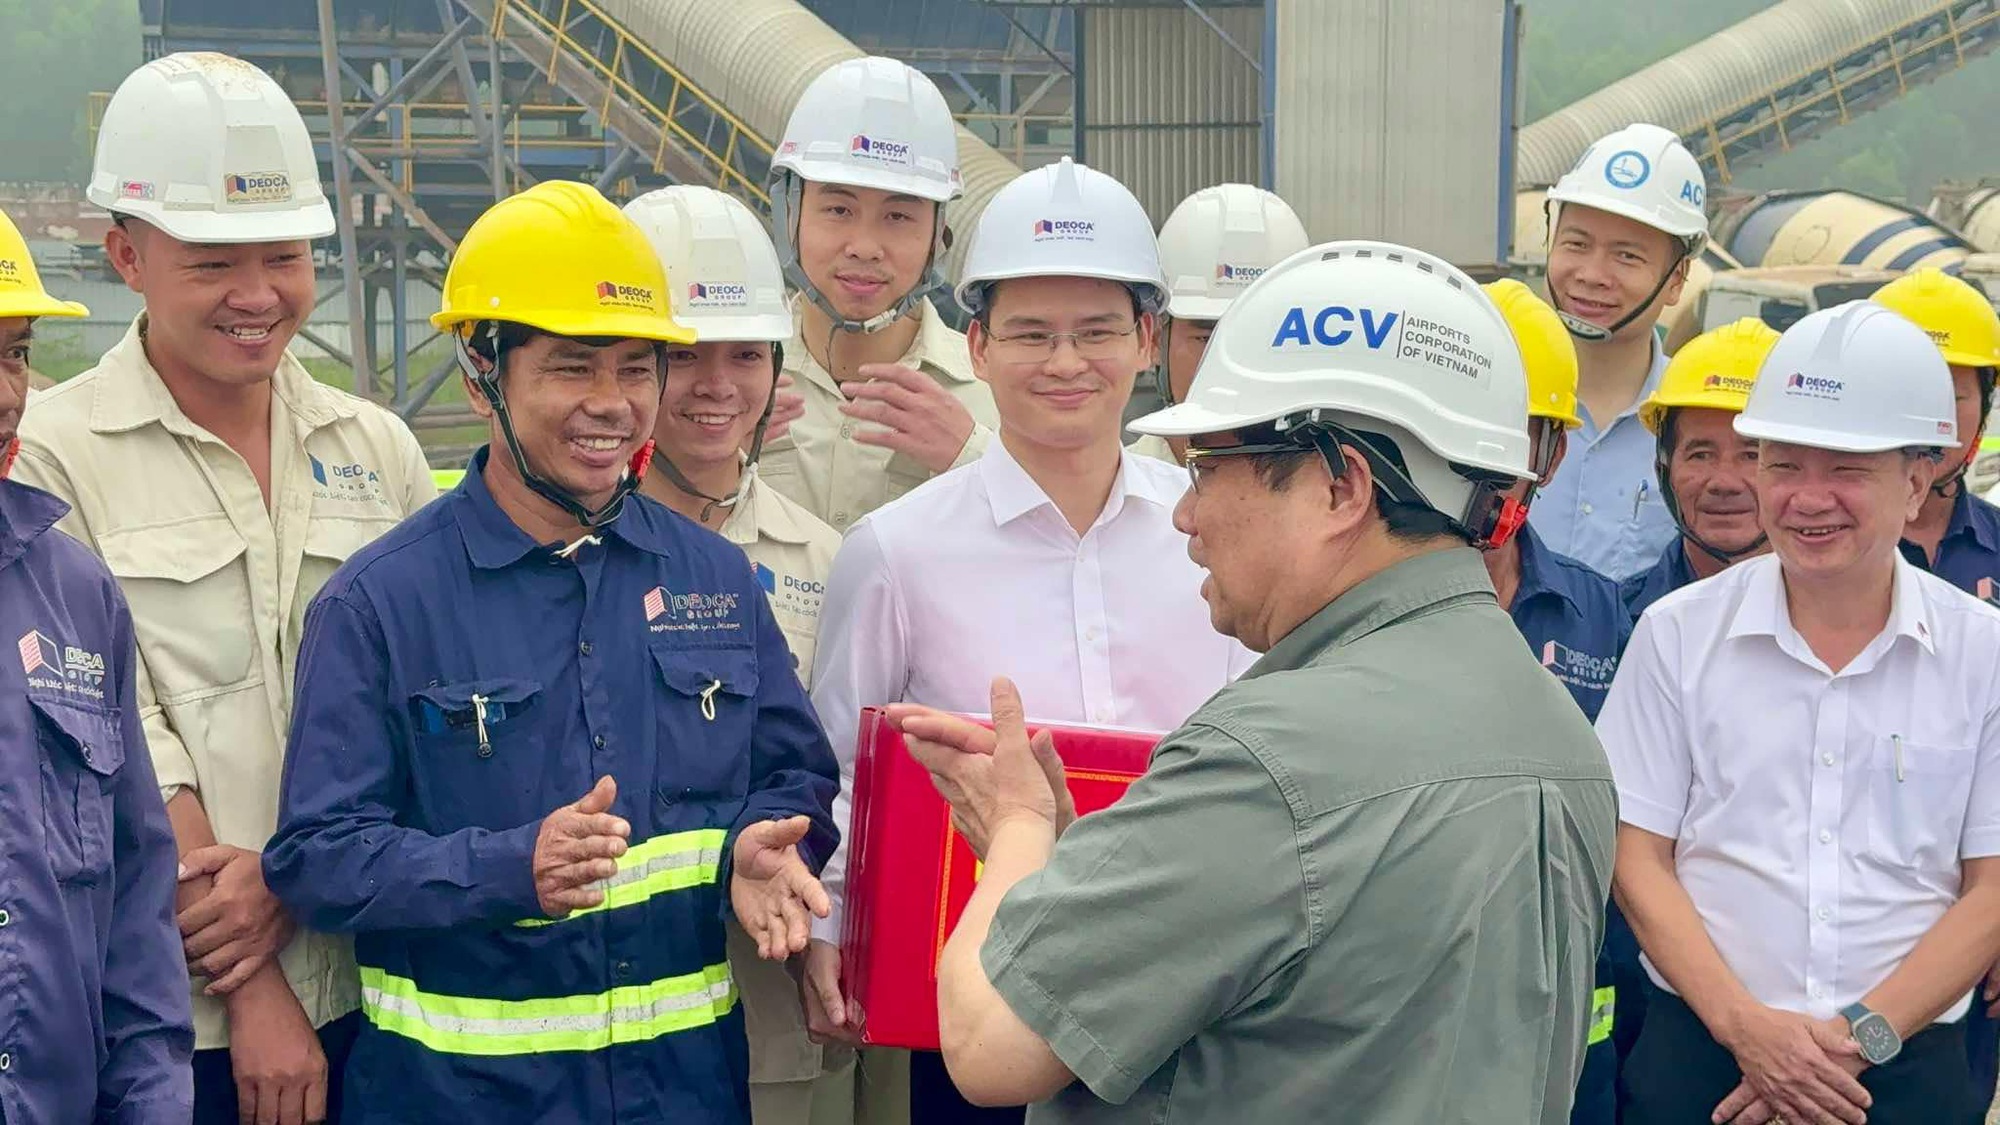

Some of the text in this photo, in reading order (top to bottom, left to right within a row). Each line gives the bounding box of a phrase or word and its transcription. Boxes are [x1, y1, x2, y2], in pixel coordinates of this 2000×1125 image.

[872, 140, 908, 154] DEOCA
[249, 177, 290, 188] DEOCA
[1680, 179, 1705, 206] AC
[1055, 221, 1093, 231] DEOCA
[1235, 267, 1267, 276] DEOC
[618, 285, 653, 300] DEOCA
[709, 285, 746, 294] DEOCA
[1271, 306, 1399, 349] ACV
[1406, 316, 1471, 345] AIRPORTS
[1405, 330, 1492, 369] CORPORATION
[1402, 344, 1479, 379] OF VIETNAM
[1806, 377, 1843, 390] DEOCA
